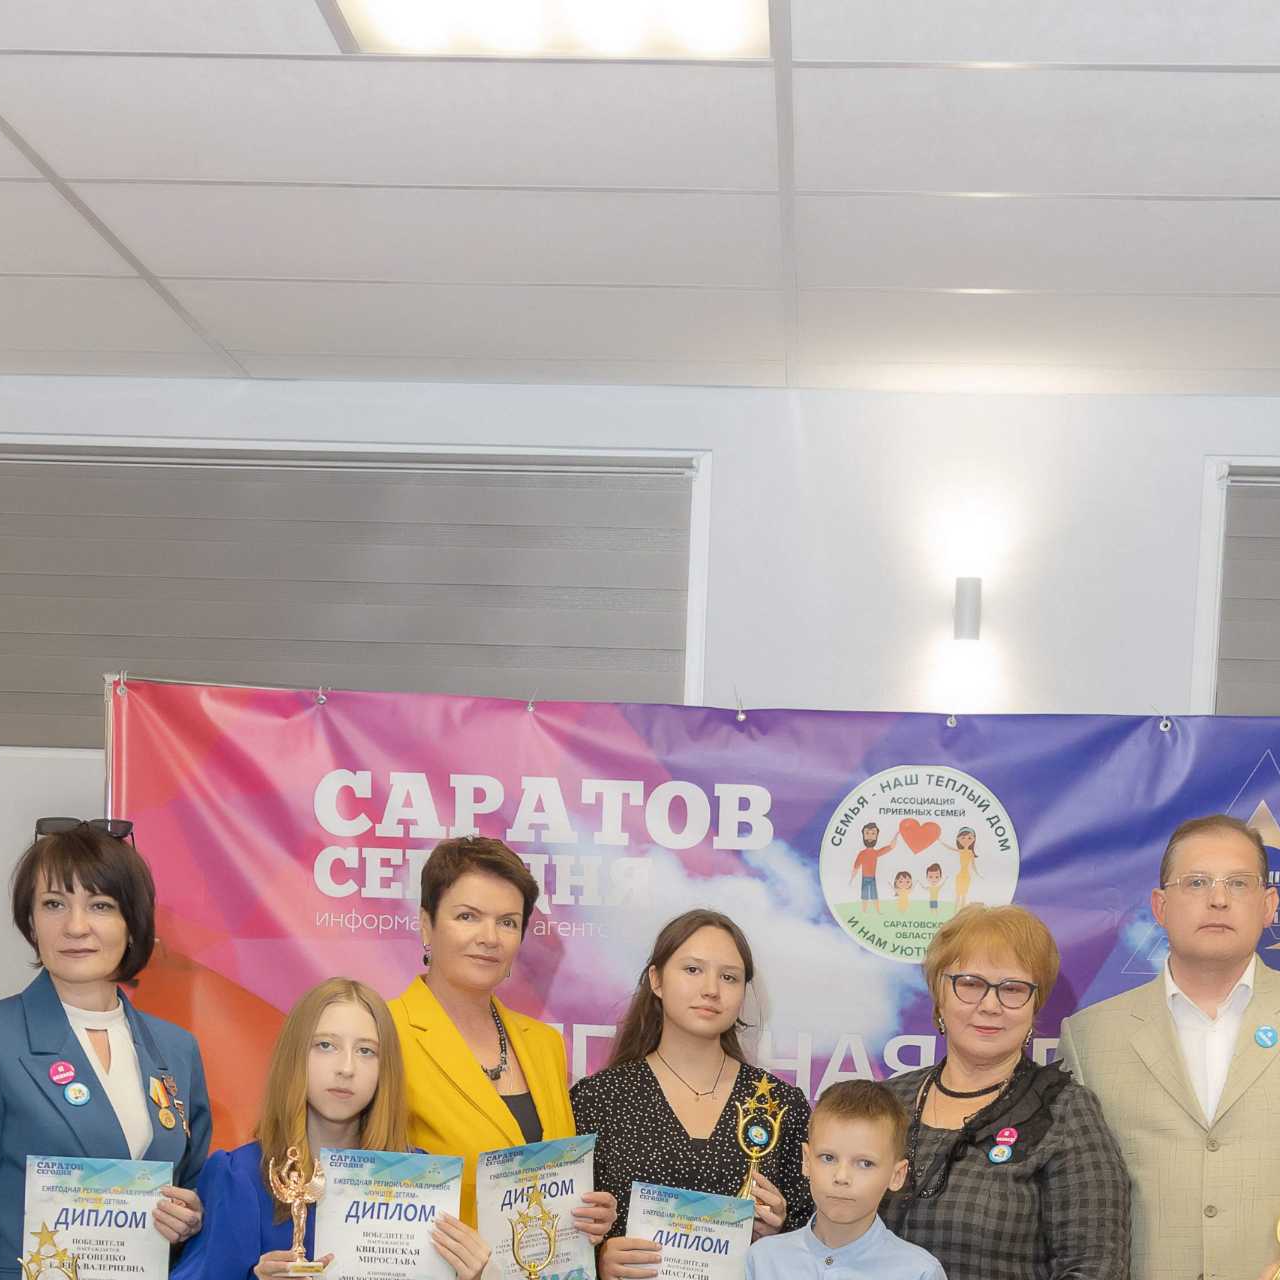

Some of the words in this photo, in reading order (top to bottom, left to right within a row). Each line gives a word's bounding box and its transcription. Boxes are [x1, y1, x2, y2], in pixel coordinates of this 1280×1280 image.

[314, 768, 774, 850] САРАТОВ
[831, 796, 869, 847] СЕМЬЯ
[880, 774, 919, 793] НАШ
[926, 774, 991, 813] ТЕПЛЫЙ
[986, 814, 1011, 852] ДОМ
[879, 807, 932, 816] ПРИЕМНЫХ
[934, 807, 966, 817] СЕМЕЙ
[890, 797, 956, 806] АССОЦИАЦИЯ
[314, 845, 653, 914] СЕДНЯ
[848, 916, 859, 928] И
[857, 928, 887, 950] НАМ
[890, 942, 929, 957] УЮТ
[883, 921, 945, 929] САРАТОВСКО
[37, 1162, 83, 1170] САРАТОВ
[330, 1155, 375, 1164] САРАТОВ
[54, 1207, 146, 1230] ДИПЛОМ
[345, 1201, 435, 1224] ДИПЛОМ
[652, 1230, 730, 1255] ДИПЛОМ
